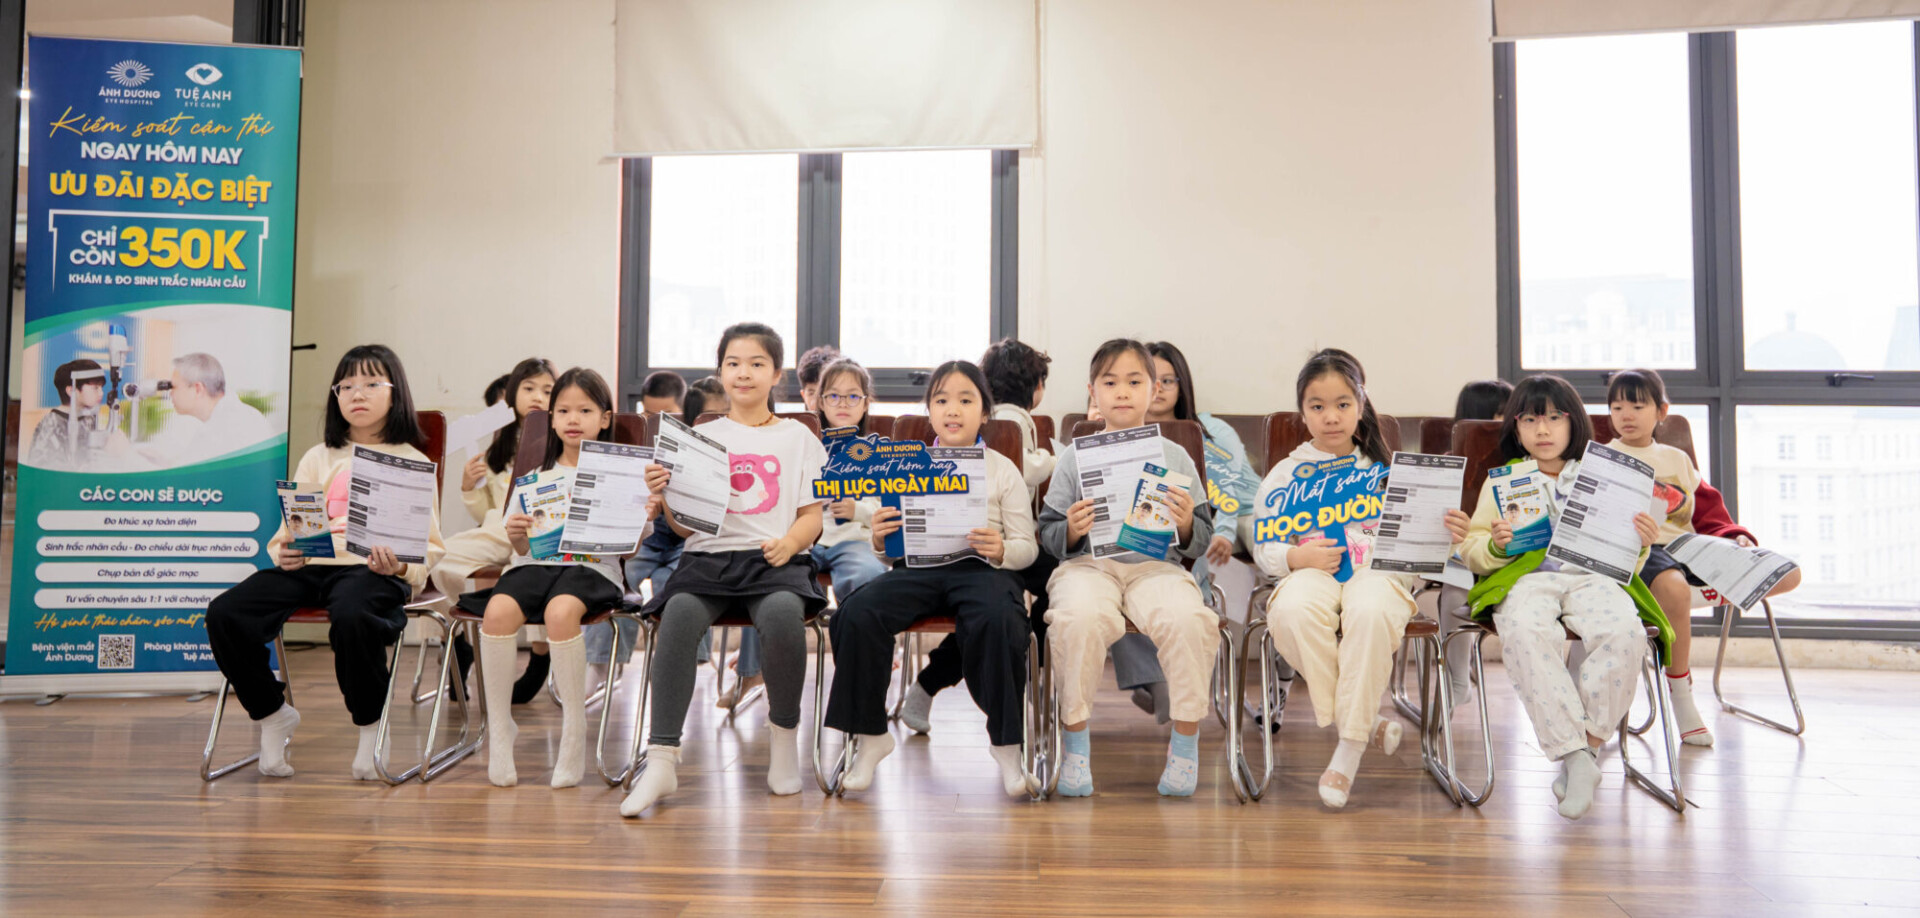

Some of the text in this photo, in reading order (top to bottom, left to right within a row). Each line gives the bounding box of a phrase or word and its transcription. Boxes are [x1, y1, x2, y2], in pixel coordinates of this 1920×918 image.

[98, 86, 161, 99] ÁNH DƯƠNG
[174, 87, 232, 101] TUỆ ANH
[50, 106, 274, 142] Kiểm soát cận thị
[81, 140, 243, 165] NGAY HÔM NAY
[50, 170, 272, 208] ƯU ĐÃI ĐẶC BIỆT
[81, 225, 117, 246] CHỈ
[69, 246, 116, 266] CÒN
[118, 226, 248, 270] 350K
[68, 272, 102, 284] KHÁM
[104, 275, 112, 284] &
[116, 275, 132, 285] ĐO
[134, 276, 158, 286] SINH
[160, 273, 188, 287] TRẮC
[876, 444, 922, 453] ÁNH DƯƠNG
[866, 458, 900, 476] soát
[896, 458, 925, 472] hôm
[929, 461, 954, 480] nay
[814, 473, 967, 500] THỊ LỰC NGÀY MAI
[1268, 464, 1390, 513] Mắt sáng
[80, 485, 223, 506] CÁC CON SẼ ĐƯỢC
[104, 517, 197, 528] Đo khúc xạ toàn diện
[1256, 511, 1312, 542] HỌC
[1317, 494, 1386, 528] ĐƯỜN
[44, 543, 64, 551] Sinh
[134, 543, 147, 551] Đo
[174, 542, 190, 552] dài
[97, 569, 122, 579] Chụp
[156, 568, 177, 579] giác
[66, 594, 77, 603] Tư
[96, 594, 129, 604] chuyên
[150, 595, 162, 603] 1:1
[60, 614, 90, 629] sinh
[91, 613, 118, 630] thái
[120, 612, 152, 626] chăm
[32, 642, 54, 653] Bệnh
[56, 642, 75, 653] viện
[144, 642, 172, 653] Phòng
[174, 642, 198, 651] khám
[45, 650, 94, 664] Ánh Dương
[182, 652, 198, 662] Tuệ
